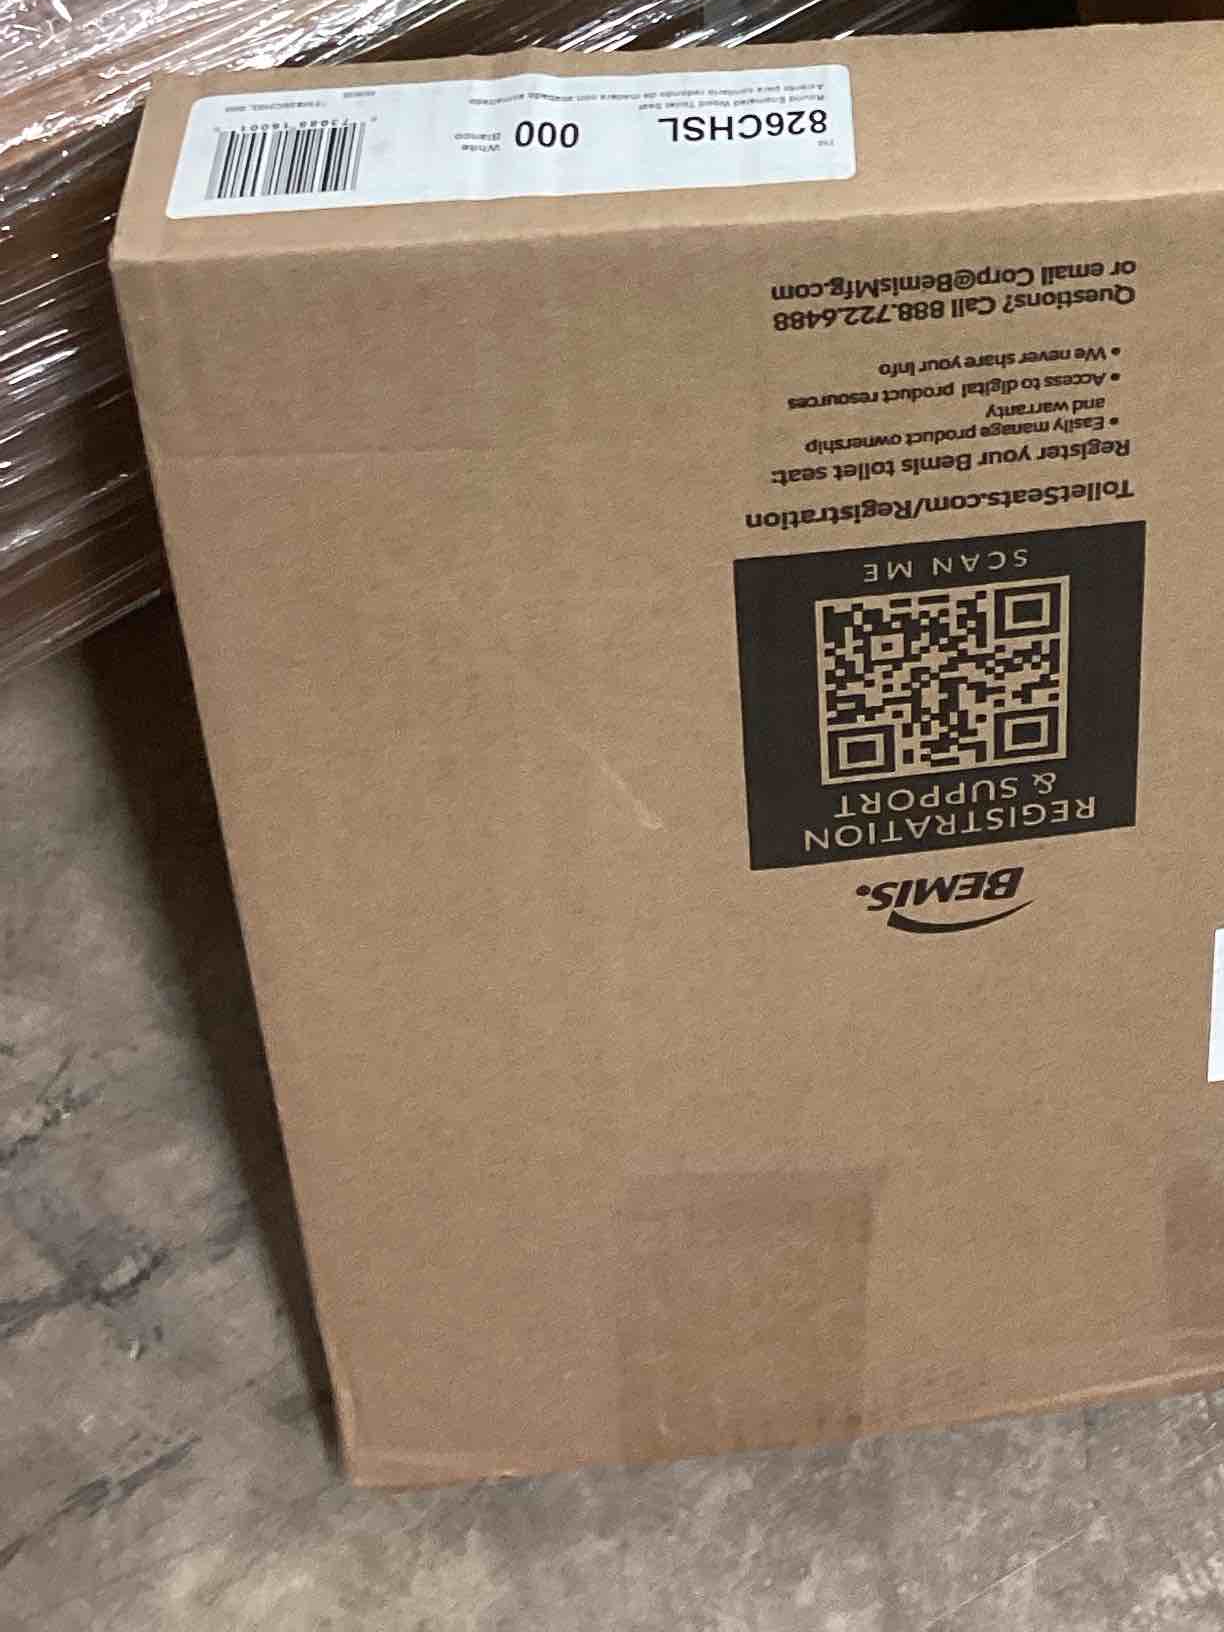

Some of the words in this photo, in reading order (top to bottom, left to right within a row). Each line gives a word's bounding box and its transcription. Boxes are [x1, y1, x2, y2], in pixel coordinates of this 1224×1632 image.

[513, 117, 579, 151] 000
[657, 109, 827, 144] 826CHSL
[1041, 261, 1104, 285] email
[1109, 261, 1136, 280] or
[770, 266, 1034, 302] Corp@BemisMfg.com
[951, 295, 996, 319] Call
[1005, 285, 1136, 314] Questions?
[773, 300, 945, 332] 888.722.6488
[918, 355, 962, 374] your
[964, 353, 1016, 371] share
[1020, 348, 1071, 365] never
[1074, 345, 1106, 362] We
[961, 379, 1018, 397] digital
[1021, 378, 1041, 392] to
[1044, 372, 1106, 388] Access
[787, 392, 880, 411] resources
[882, 382, 955, 403] product
[985, 400, 1070, 420] warranty
[1071, 397, 1105, 414] and
[904, 423, 977, 446] product
[979, 420, 1050, 439] manage
[1052, 415, 1105, 433] Easily
[804, 432, 902, 455] ownership
[1037, 438, 1130, 462] Register
[901, 453, 972, 475] Bemis
[977, 445, 1031, 468] your
[770, 466, 828, 487] seat:
[833, 460, 895, 481] toilet
[745, 480, 1134, 530] ToiletSeats.com/Registration
[862, 560, 912, 582] ME
[930, 548, 1028, 576] SCAN
[1031, 772, 1056, 794] &
[833, 776, 1018, 818] SUPPORT
[802, 796, 1095, 851] REGISTRATION
